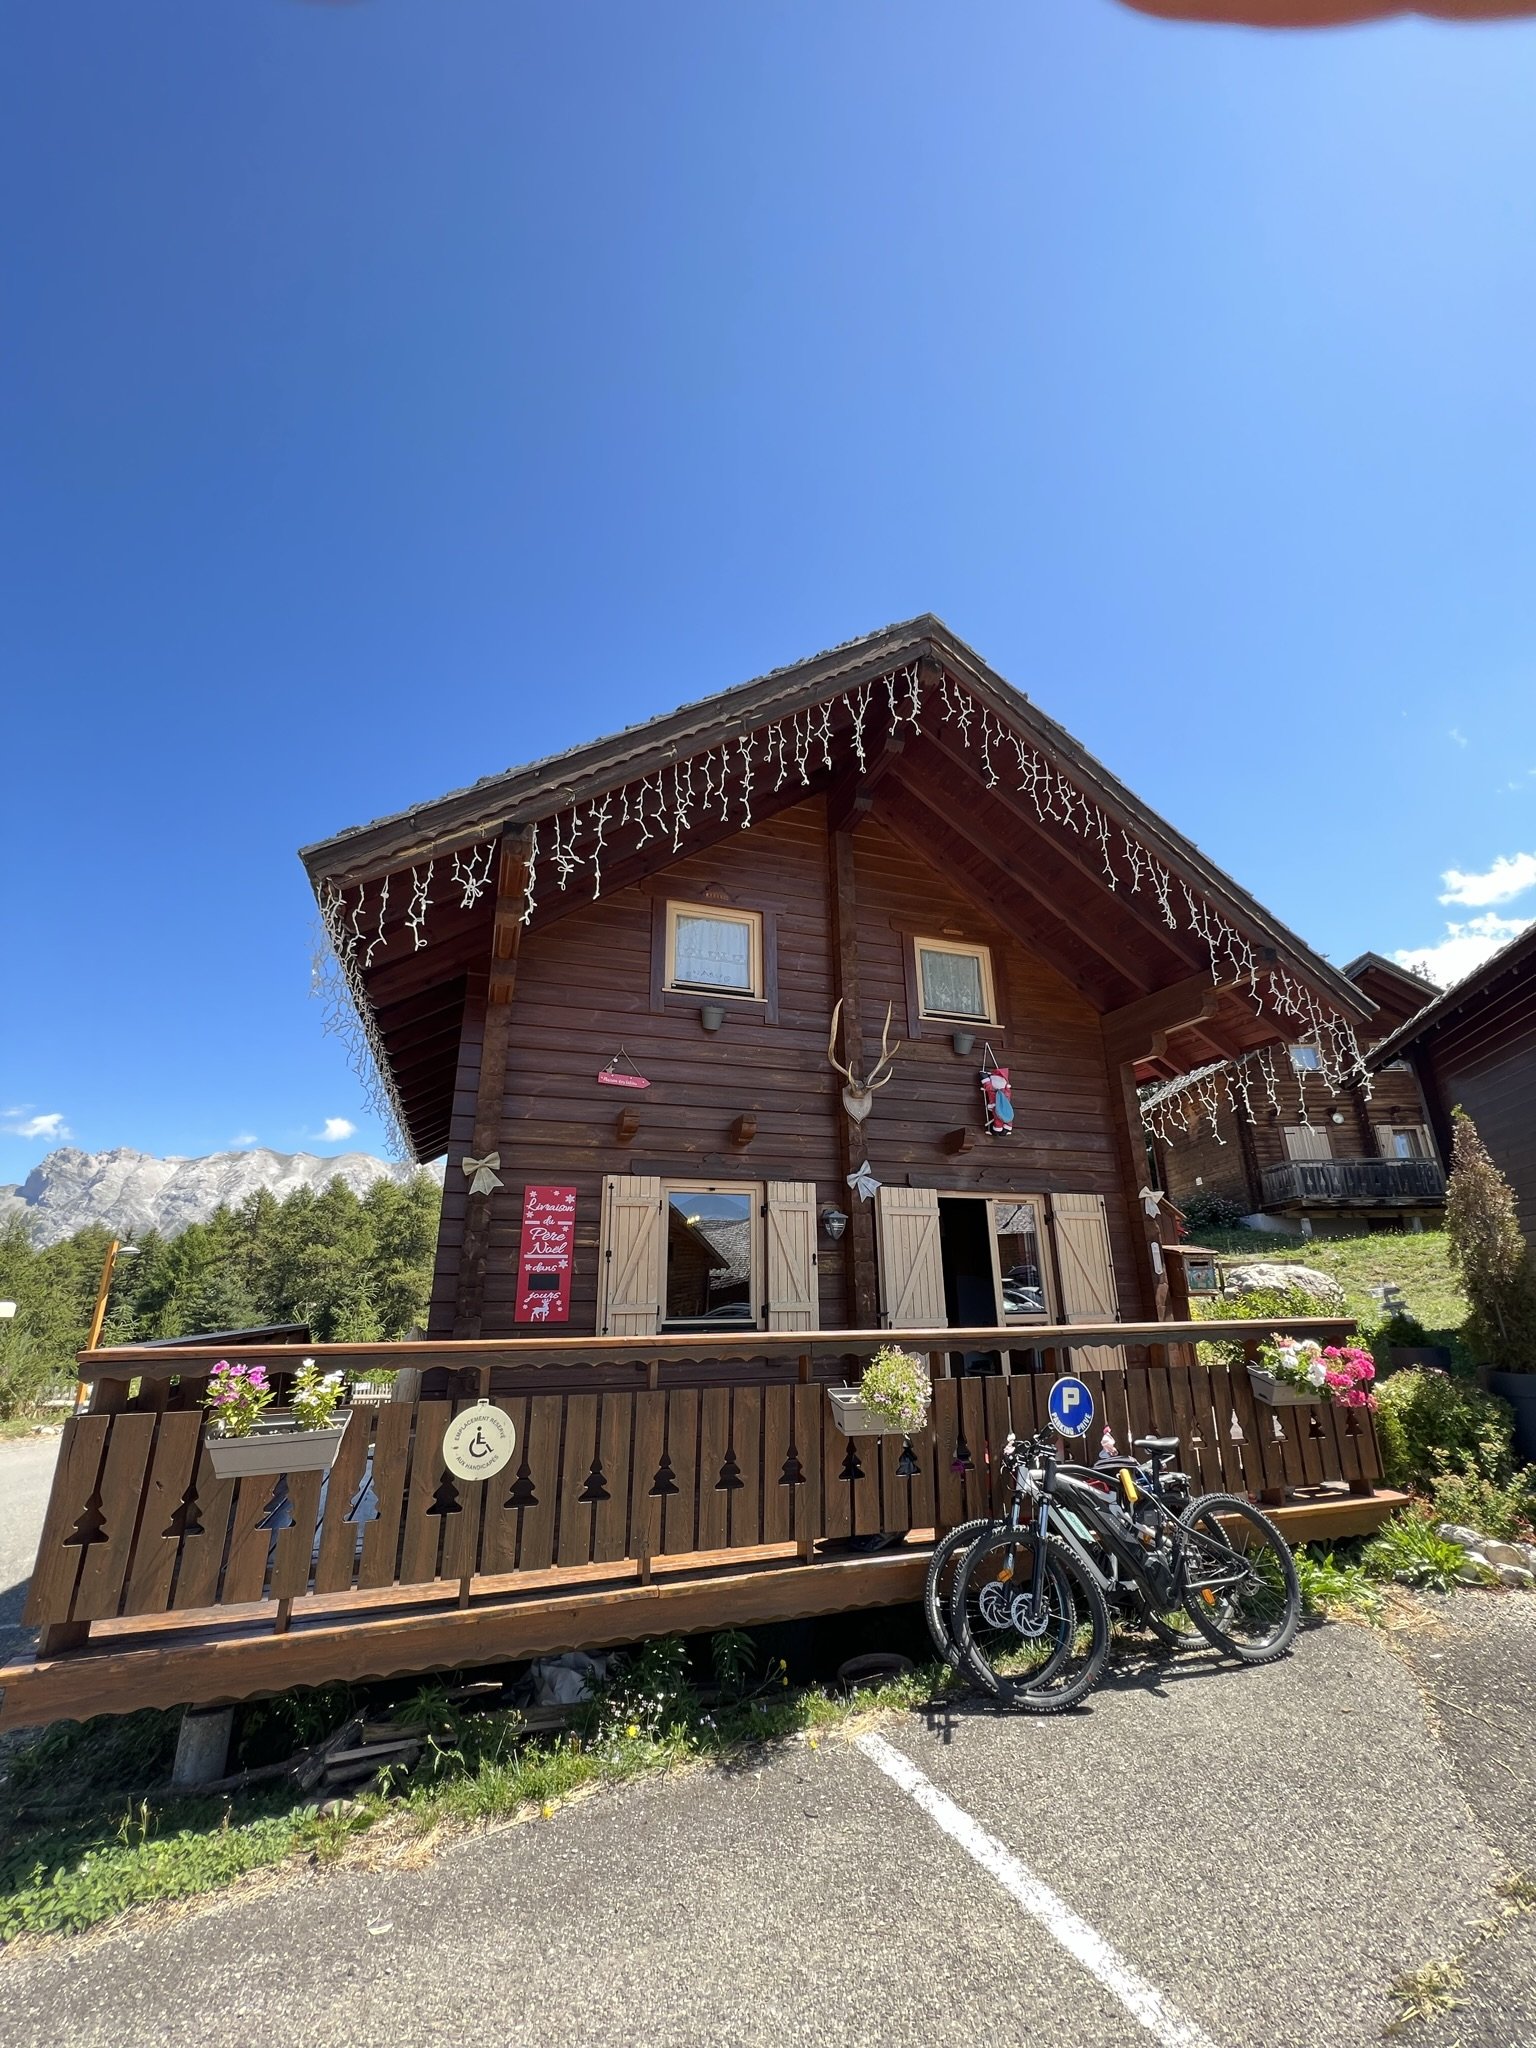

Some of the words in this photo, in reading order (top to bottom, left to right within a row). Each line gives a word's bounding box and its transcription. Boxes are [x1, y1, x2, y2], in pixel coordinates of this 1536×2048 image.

[525, 1197, 575, 1212] Livraison
[542, 1215, 555, 1226] du
[531, 1262, 558, 1273] dans
[524, 1291, 561, 1304] jours
[1062, 1387, 1079, 1413] P
[454, 1416, 489, 1440] EMPLACEMENT
[1052, 1412, 1074, 1435] PARKING
[456, 1456, 465, 1466] AUX
